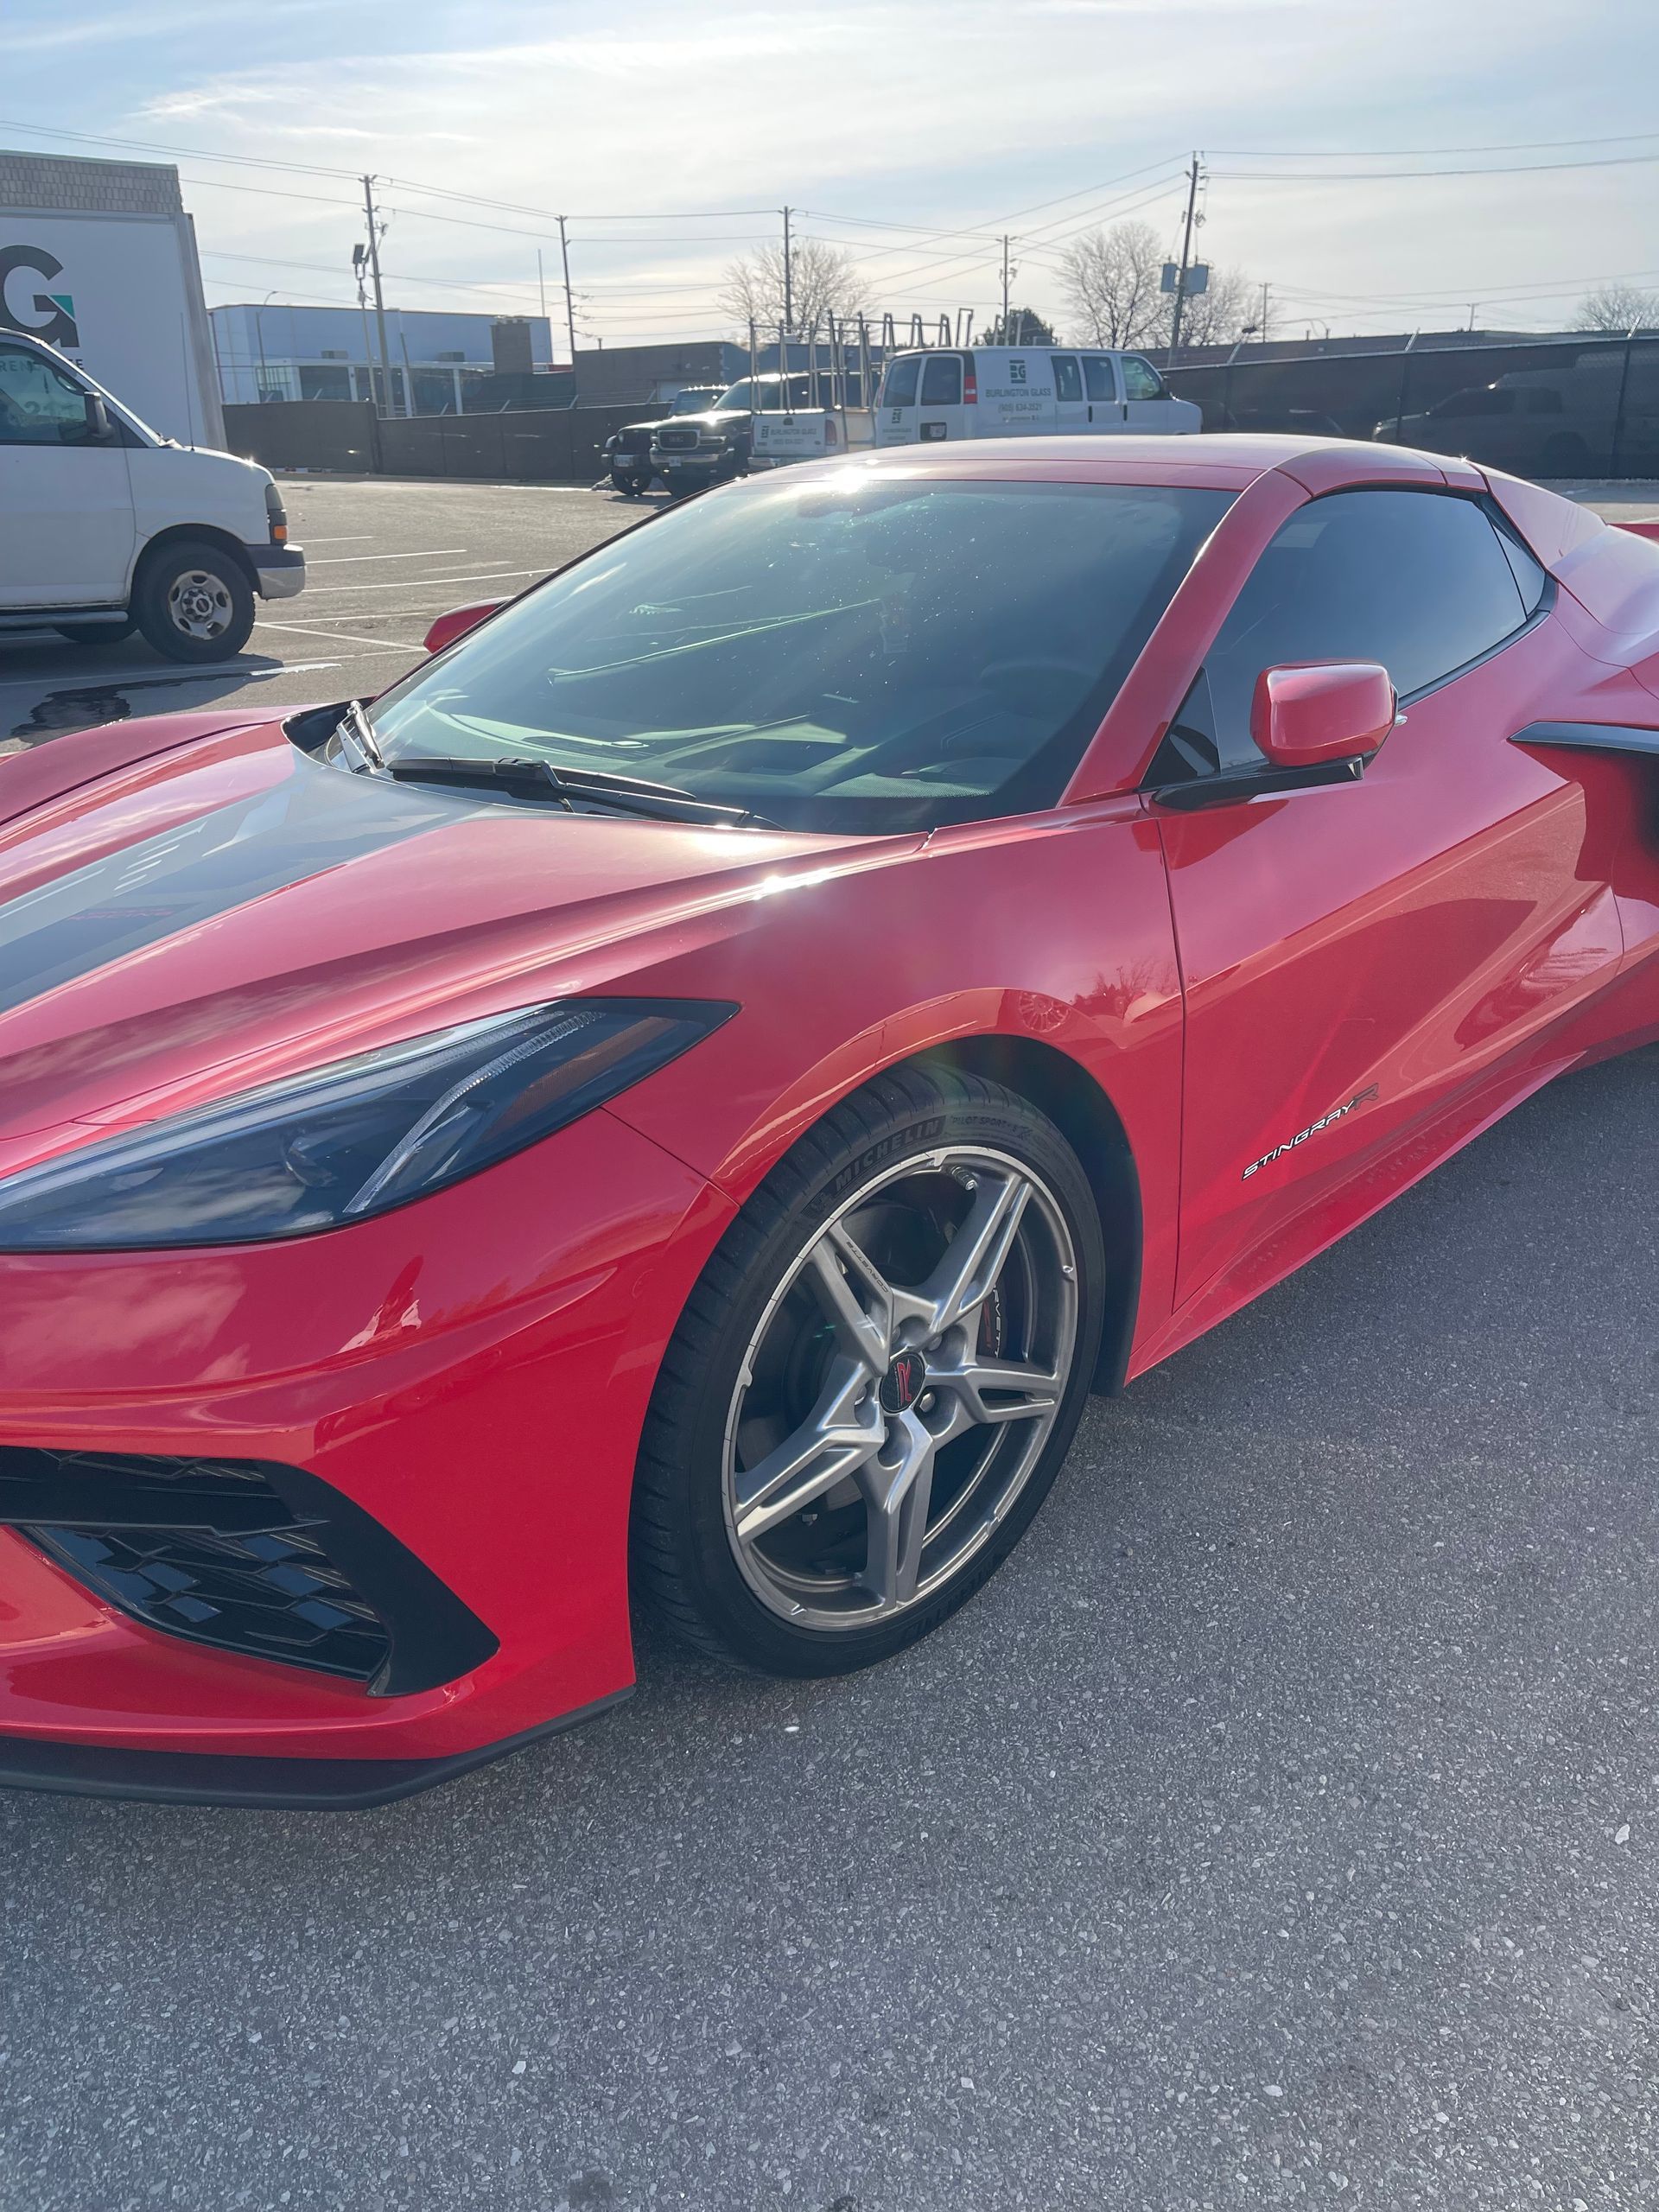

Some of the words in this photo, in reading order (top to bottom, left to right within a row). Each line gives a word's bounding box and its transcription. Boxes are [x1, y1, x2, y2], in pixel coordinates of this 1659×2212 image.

[1030, 388, 1052, 397] GLASS
[836, 1120, 940, 1192] MICHELIN
[1242, 1100, 1354, 1181] STINGRAY
[847, 1241, 888, 1293] CORVETTE
